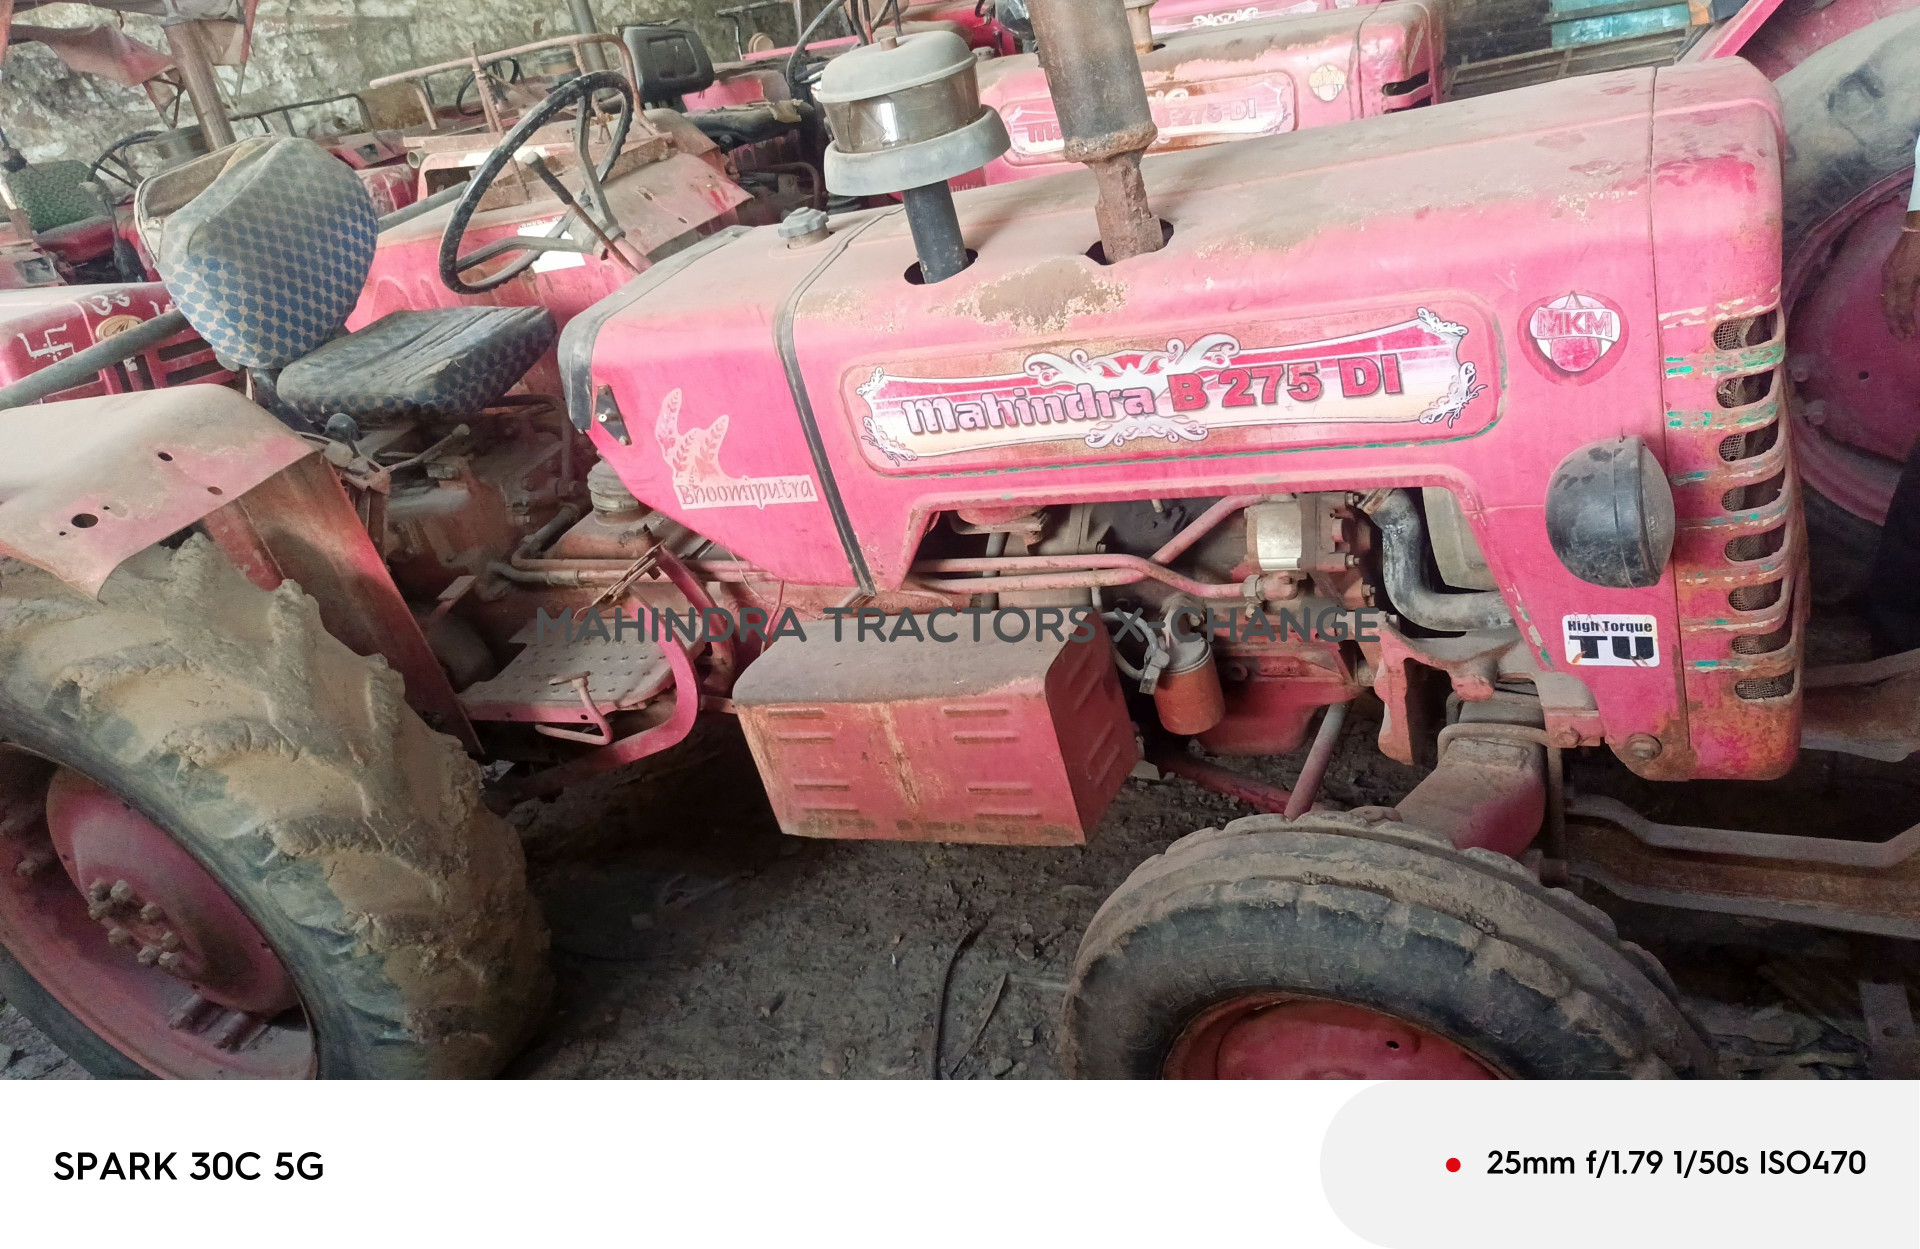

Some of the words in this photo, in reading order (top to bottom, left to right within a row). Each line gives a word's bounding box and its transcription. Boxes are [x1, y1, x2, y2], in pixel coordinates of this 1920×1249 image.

[1230, 98, 1257, 121] DI
[1536, 307, 1613, 339] MKM
[901, 384, 1158, 434] Mahindra
[1166, 371, 1209, 415] B
[1220, 362, 1324, 408] 275
[1337, 352, 1404, 398] DI
[676, 479, 815, 508] Bhoomiputra
[1567, 620, 1599, 632] High
[1602, 621, 1652, 633] Torque
[1569, 635, 1654, 660] TU
